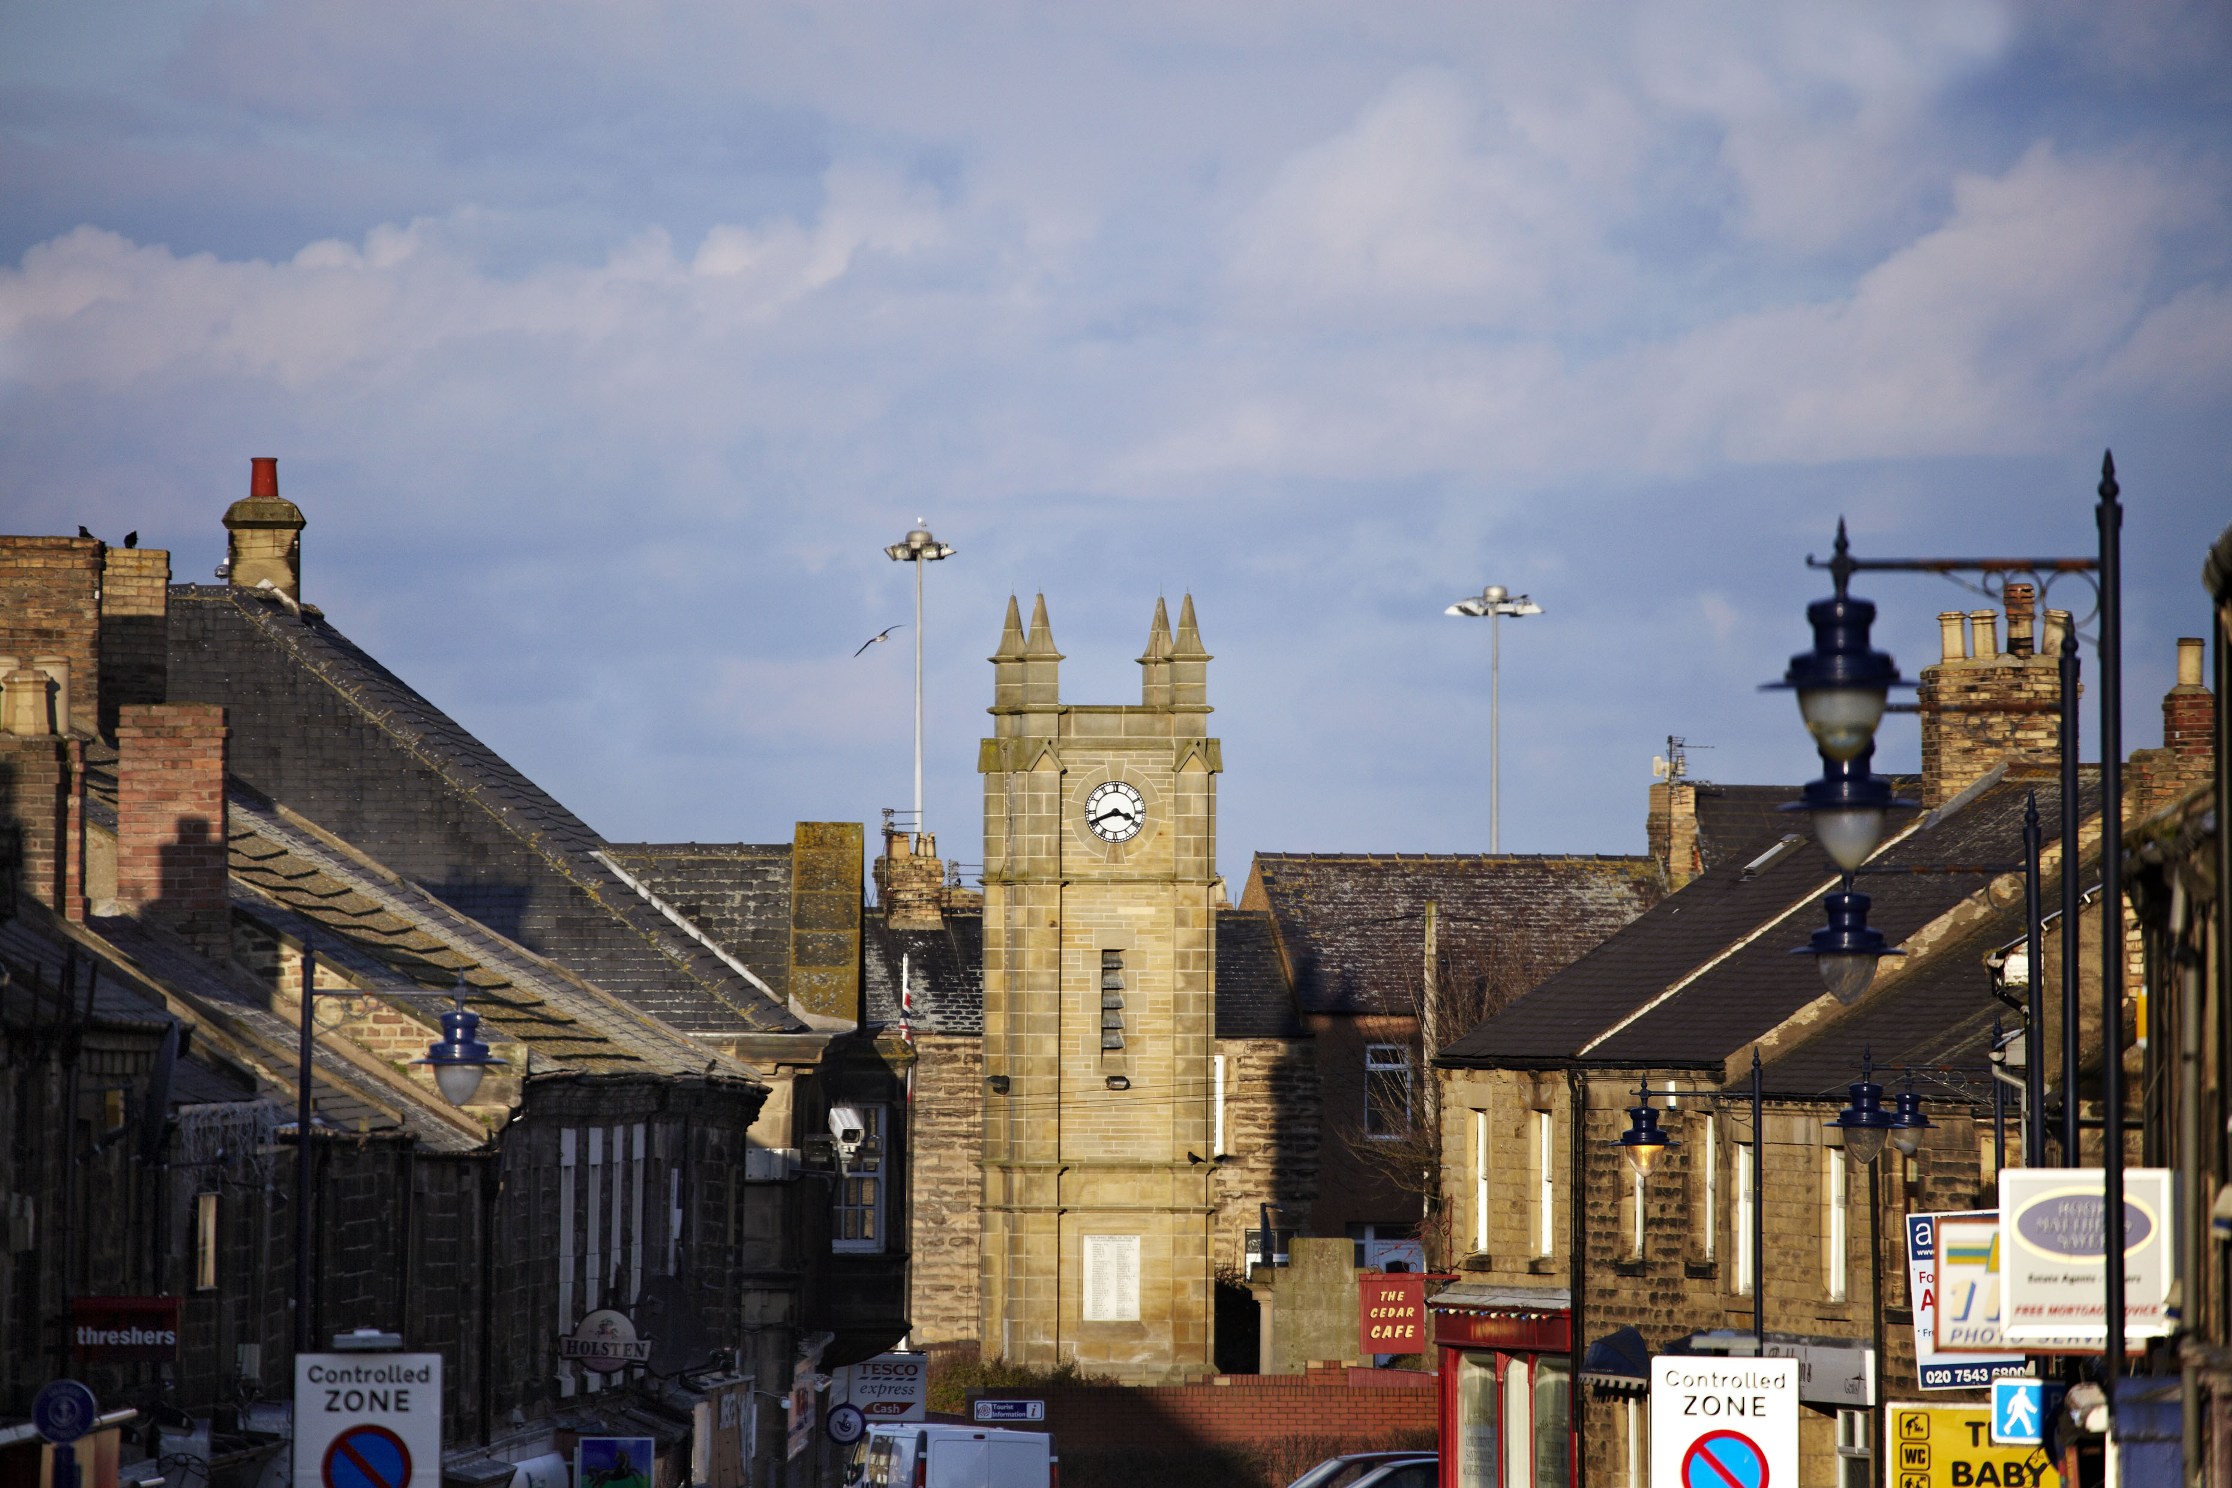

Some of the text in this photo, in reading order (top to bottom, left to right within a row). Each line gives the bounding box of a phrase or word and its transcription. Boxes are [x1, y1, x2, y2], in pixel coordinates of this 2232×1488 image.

[2036, 1216, 2133, 1234] MATTHES
[1380, 1290, 1405, 1302] THE
[1370, 1306, 1415, 1319] CEDAR
[2014, 1303, 2045, 1317] FREE
[2047, 1303, 2106, 1317] MORTGAG
[76, 1325, 176, 1346] threshers
[1370, 1324, 1415, 1339] CAFE
[565, 1340, 646, 1358] HOLSTEN
[307, 1364, 430, 1383] Controlled
[858, 1363, 918, 1376] TESCO
[1925, 1369, 1952, 1385] 020
[1954, 1367, 1989, 1383] 7543
[1665, 1369, 1787, 1390] Controlled
[860, 1383, 915, 1398] express
[324, 1389, 410, 1413] ZONE
[872, 1403, 900, 1414] Cash
[1683, 1395, 1767, 1417] ZONE
[1965, 1421, 1992, 1448] T
[1904, 1448, 1926, 1465] WC
[1952, 1460, 2048, 1488] BABY
